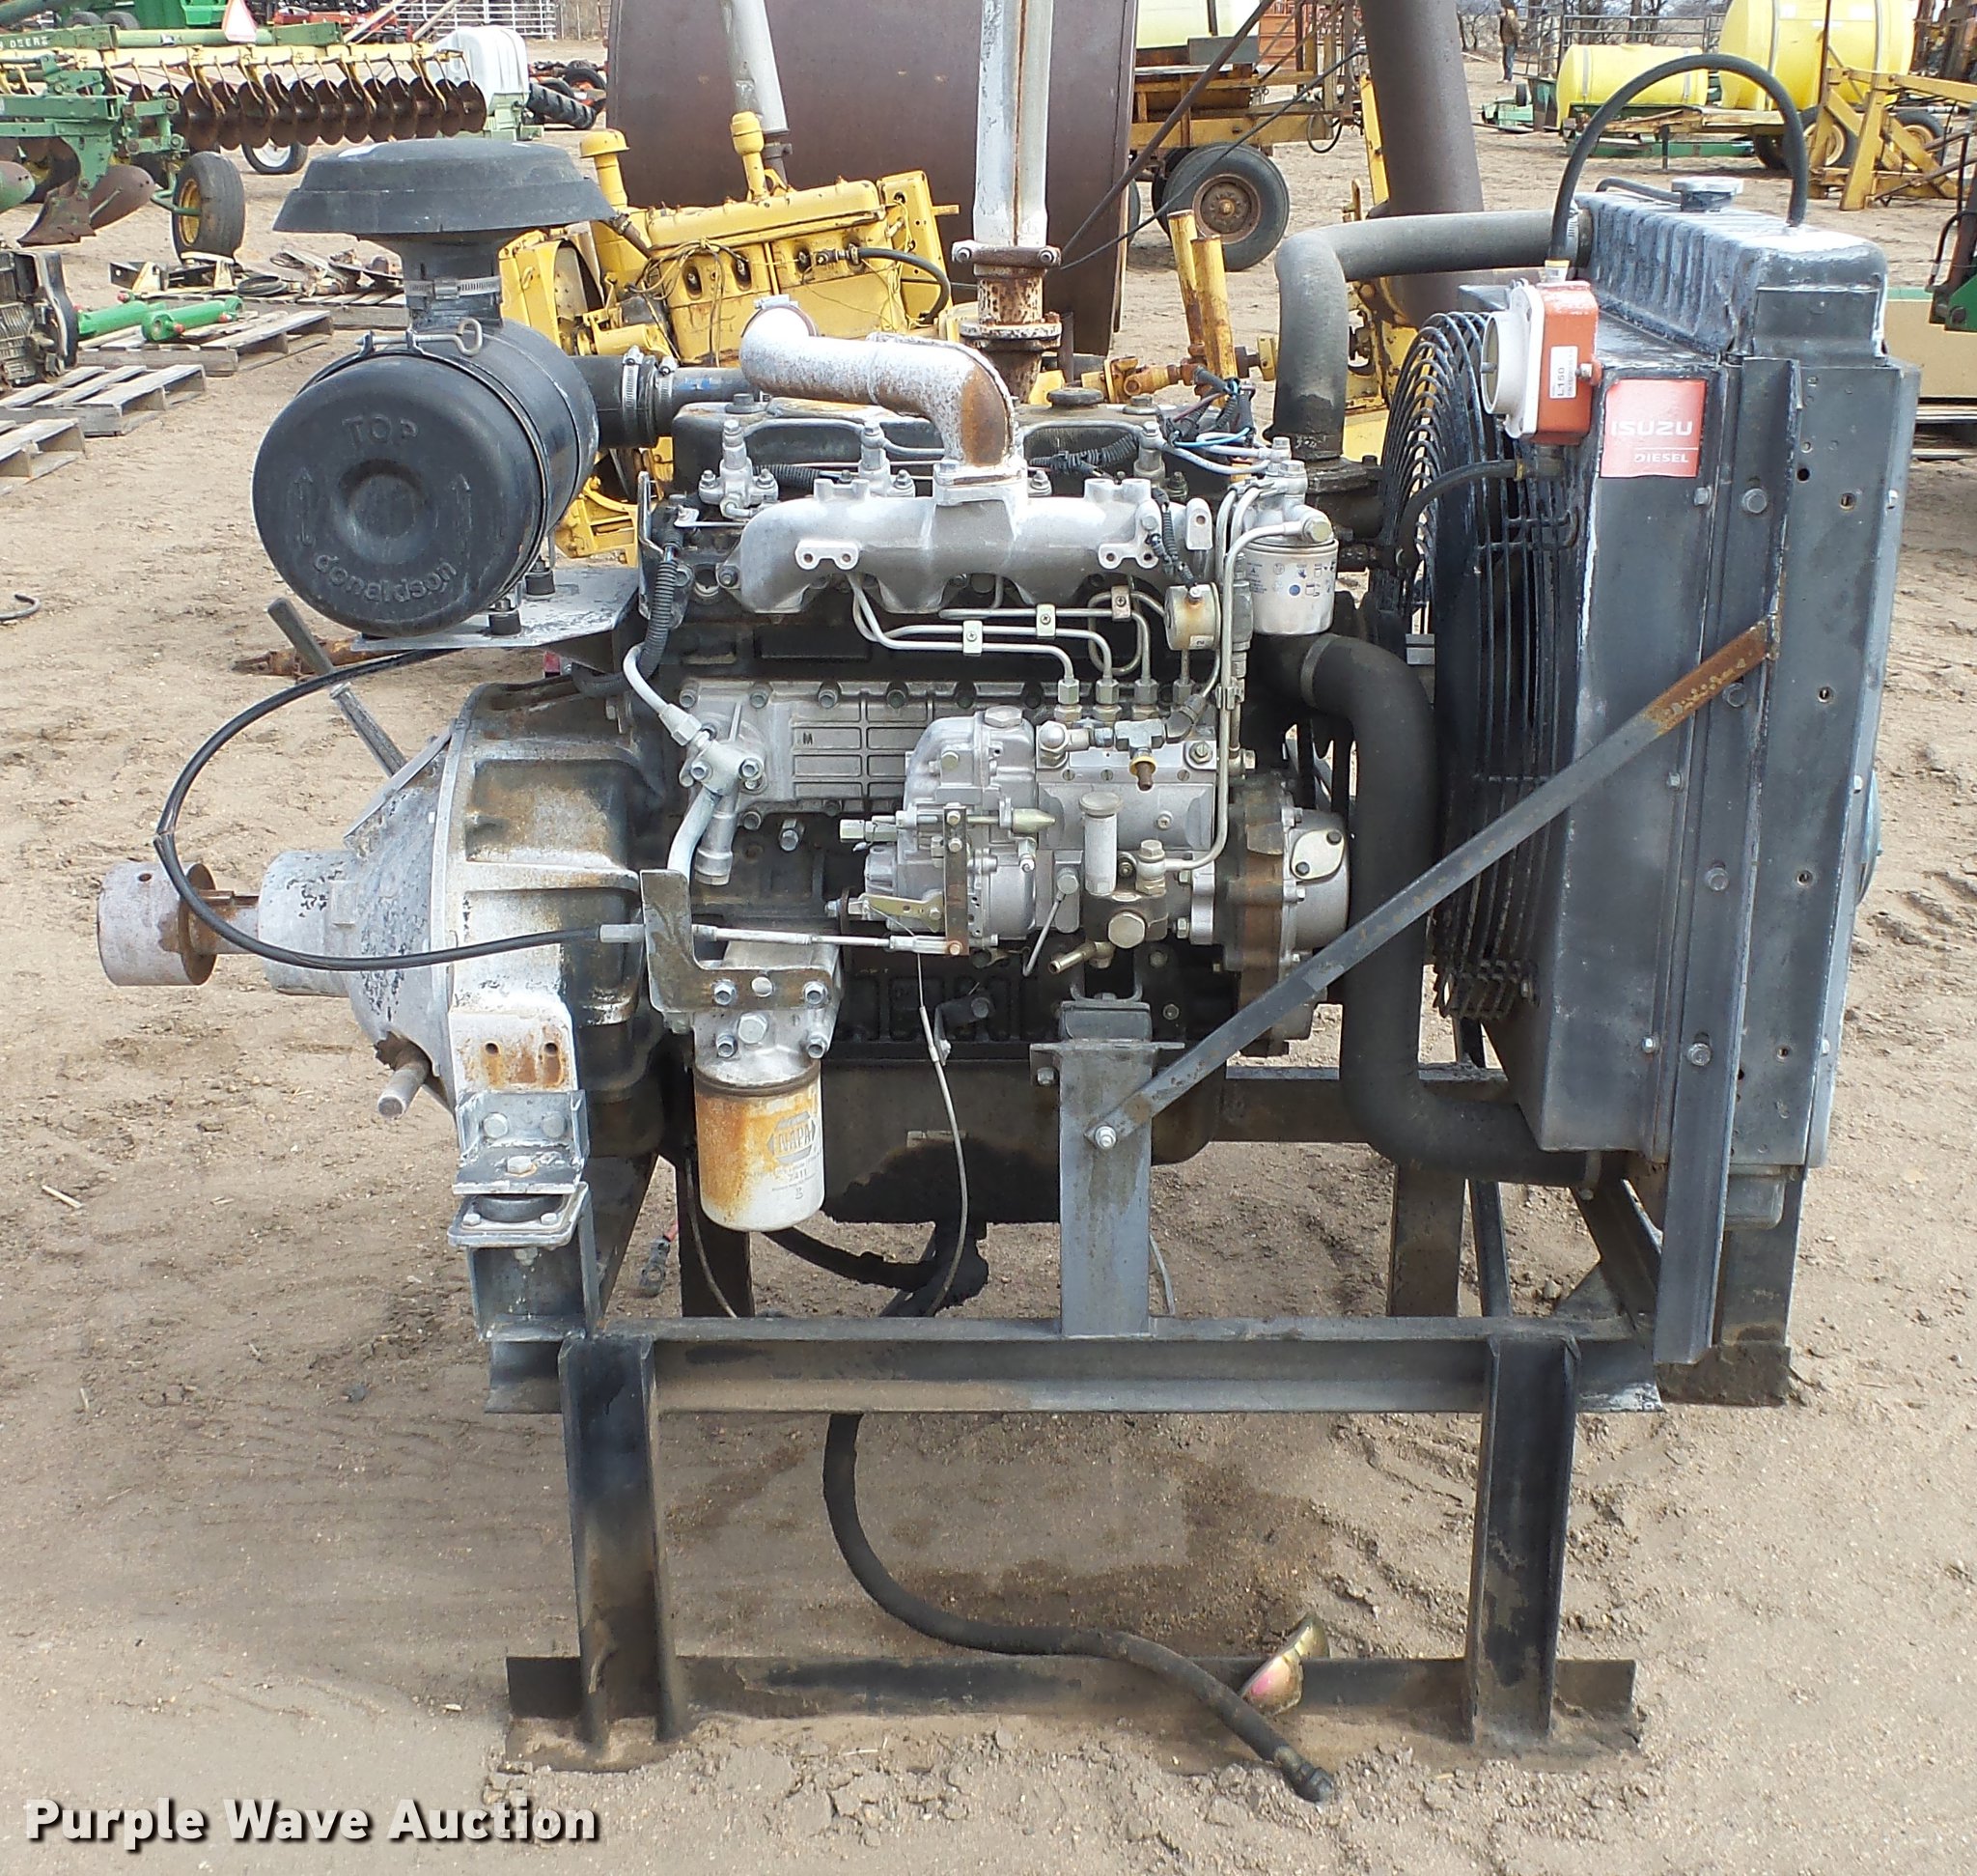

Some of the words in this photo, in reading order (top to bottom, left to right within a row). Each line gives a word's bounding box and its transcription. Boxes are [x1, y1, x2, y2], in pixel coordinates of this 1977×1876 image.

[10, 36, 48, 48] DEERE
[341, 413, 419, 449] TOP
[1609, 420, 1693, 436] ISUZU
[1633, 453, 1689, 463] DIESEL
[313, 553, 458, 602] donaldson
[778, 1122, 812, 1153] NAPA
